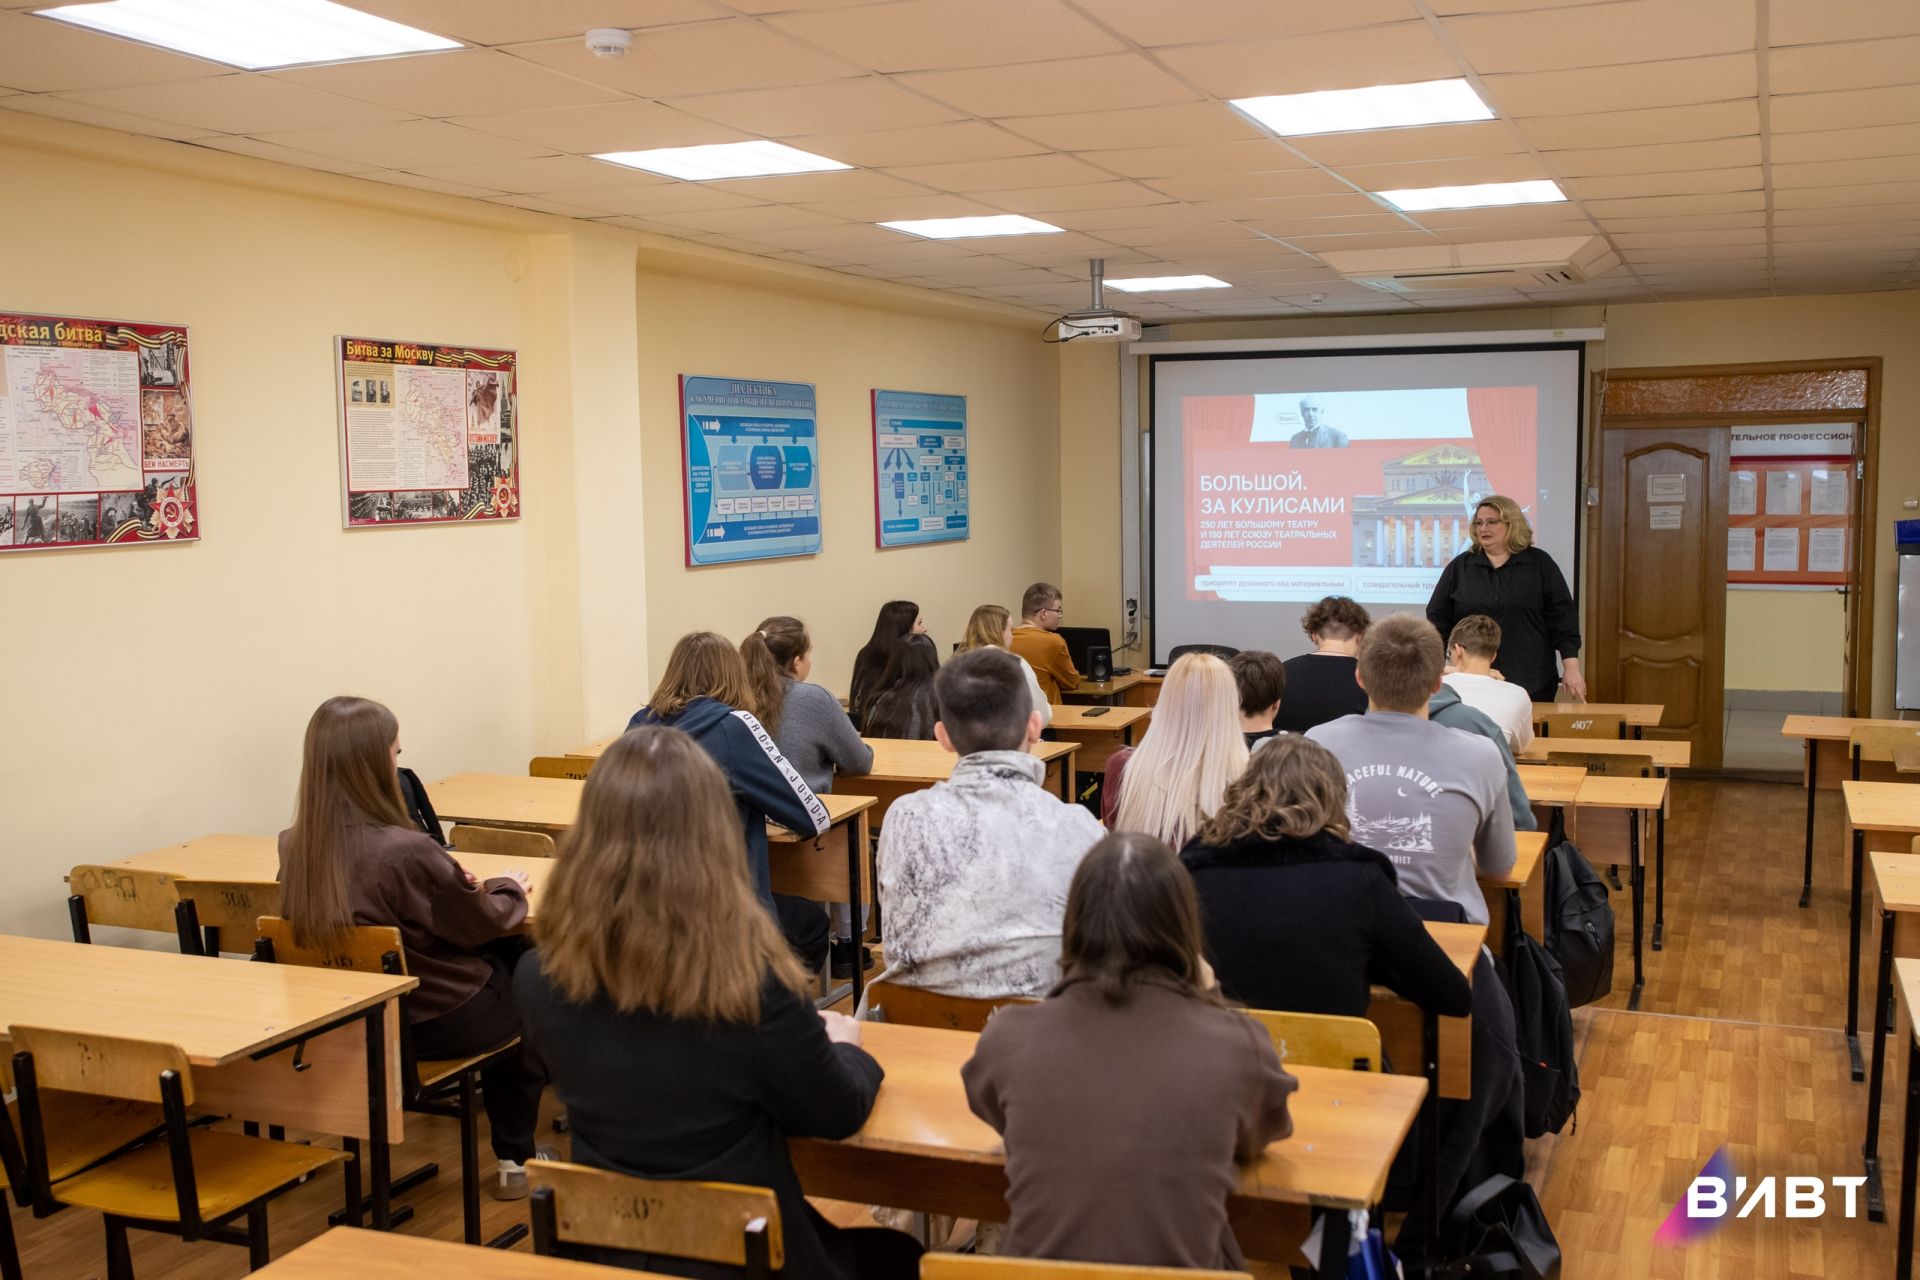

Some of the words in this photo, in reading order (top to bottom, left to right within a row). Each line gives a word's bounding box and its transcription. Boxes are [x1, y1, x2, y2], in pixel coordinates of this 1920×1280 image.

[55, 321, 103, 343] битва
[347, 341, 378, 357] Битва
[381, 346, 392, 358] за
[395, 344, 434, 364] Москву
[730, 383, 777, 396] ДИАЛЕКТИКА
[1200, 471, 1307, 491] БОЛЬШОЙ.
[1201, 498, 1226, 514] ЗА
[1231, 496, 1345, 514] КУЛИСАМИ
[1200, 520, 1215, 529] 250
[1217, 520, 1233, 528] ЛЕТ
[1235, 520, 1285, 528] БОЛЬШОМУ
[1287, 520, 1319, 528] ТЕАТРУ
[1200, 531, 1207, 539] И
[1208, 531, 1222, 539] 150
[1224, 531, 1240, 539] ЛЕТ
[1242, 530, 1272, 539] СОЮЗУ
[1275, 530, 1337, 538] ТЕАТРАЛЬНЫХ
[1200, 540, 1244, 549] ДЕЯТЕЛЕЙ
[1246, 540, 1282, 548] РОССИИ
[1238, 580, 1275, 589] духовного
[1291, 581, 1345, 589] материальным
[1363, 581, 1420, 589] созидательный
[1571, 719, 1593, 730] 407
[1396, 765, 1444, 799] NATURE
